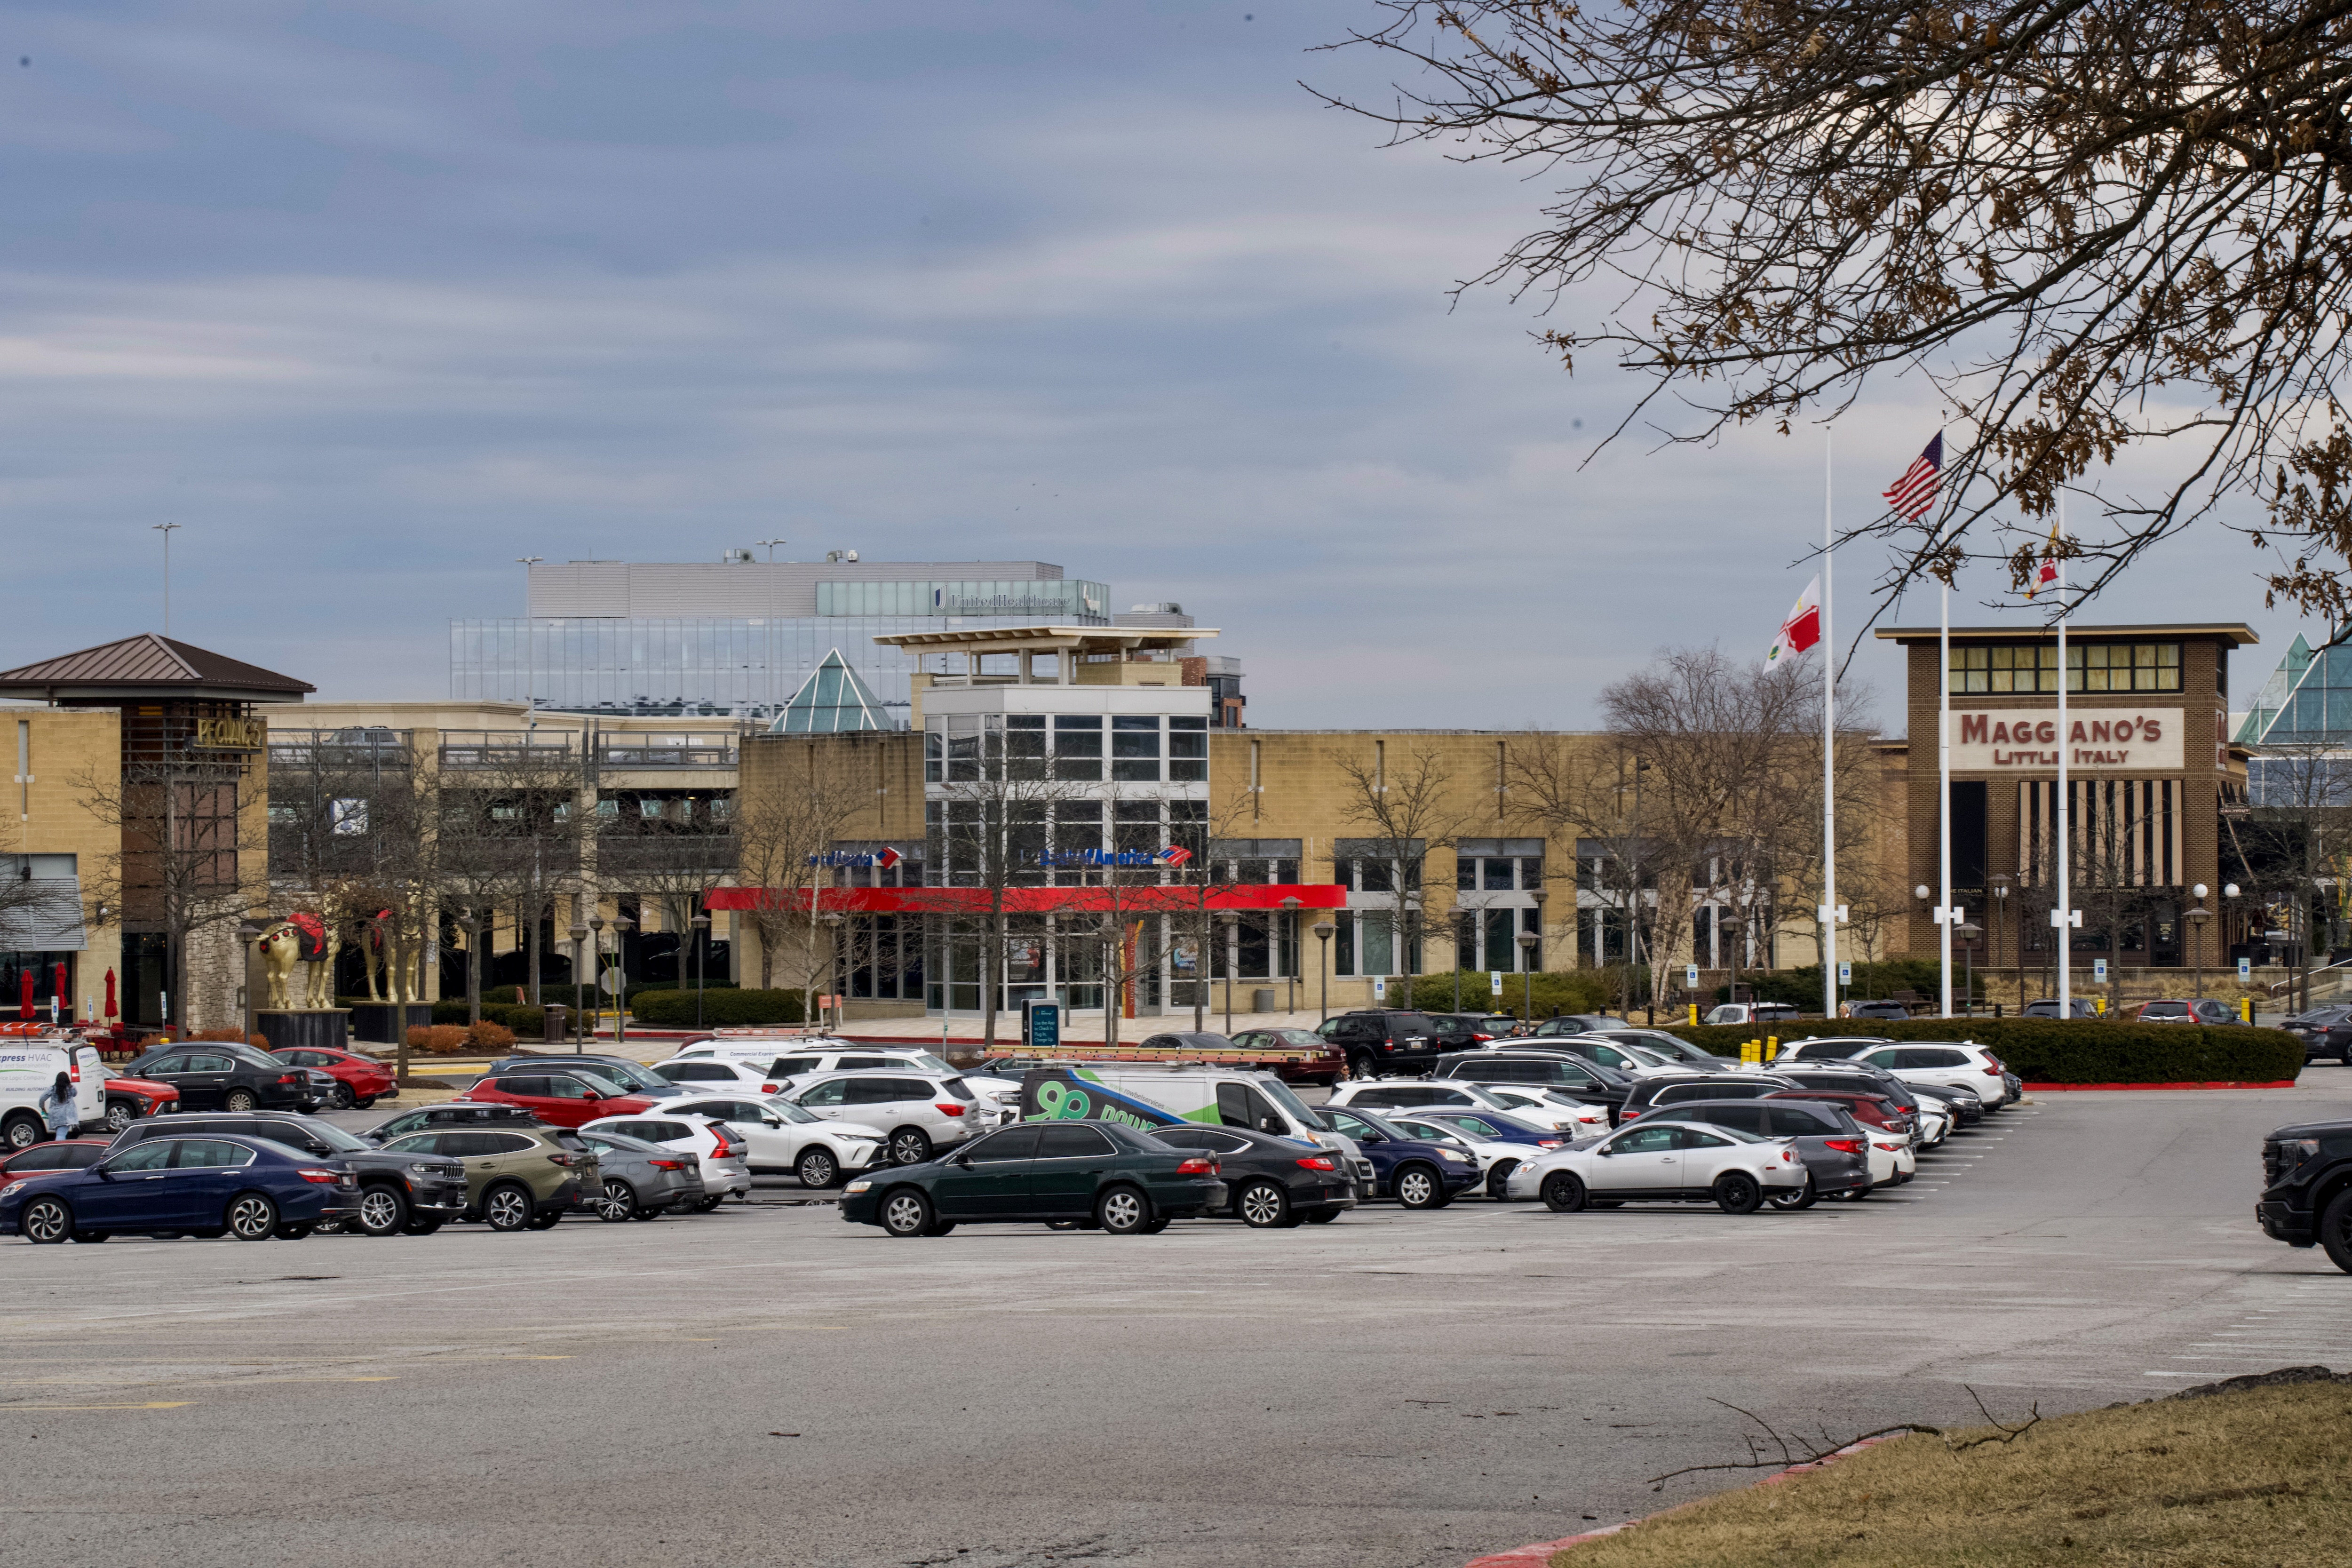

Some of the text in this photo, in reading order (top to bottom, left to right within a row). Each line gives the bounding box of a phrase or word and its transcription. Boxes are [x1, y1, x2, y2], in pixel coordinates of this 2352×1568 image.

[951, 594, 1071, 607] UnitedHealthcare
[1961, 714, 2161, 744] MAGGANO'S
[2074, 748, 2130, 764] ITALY
